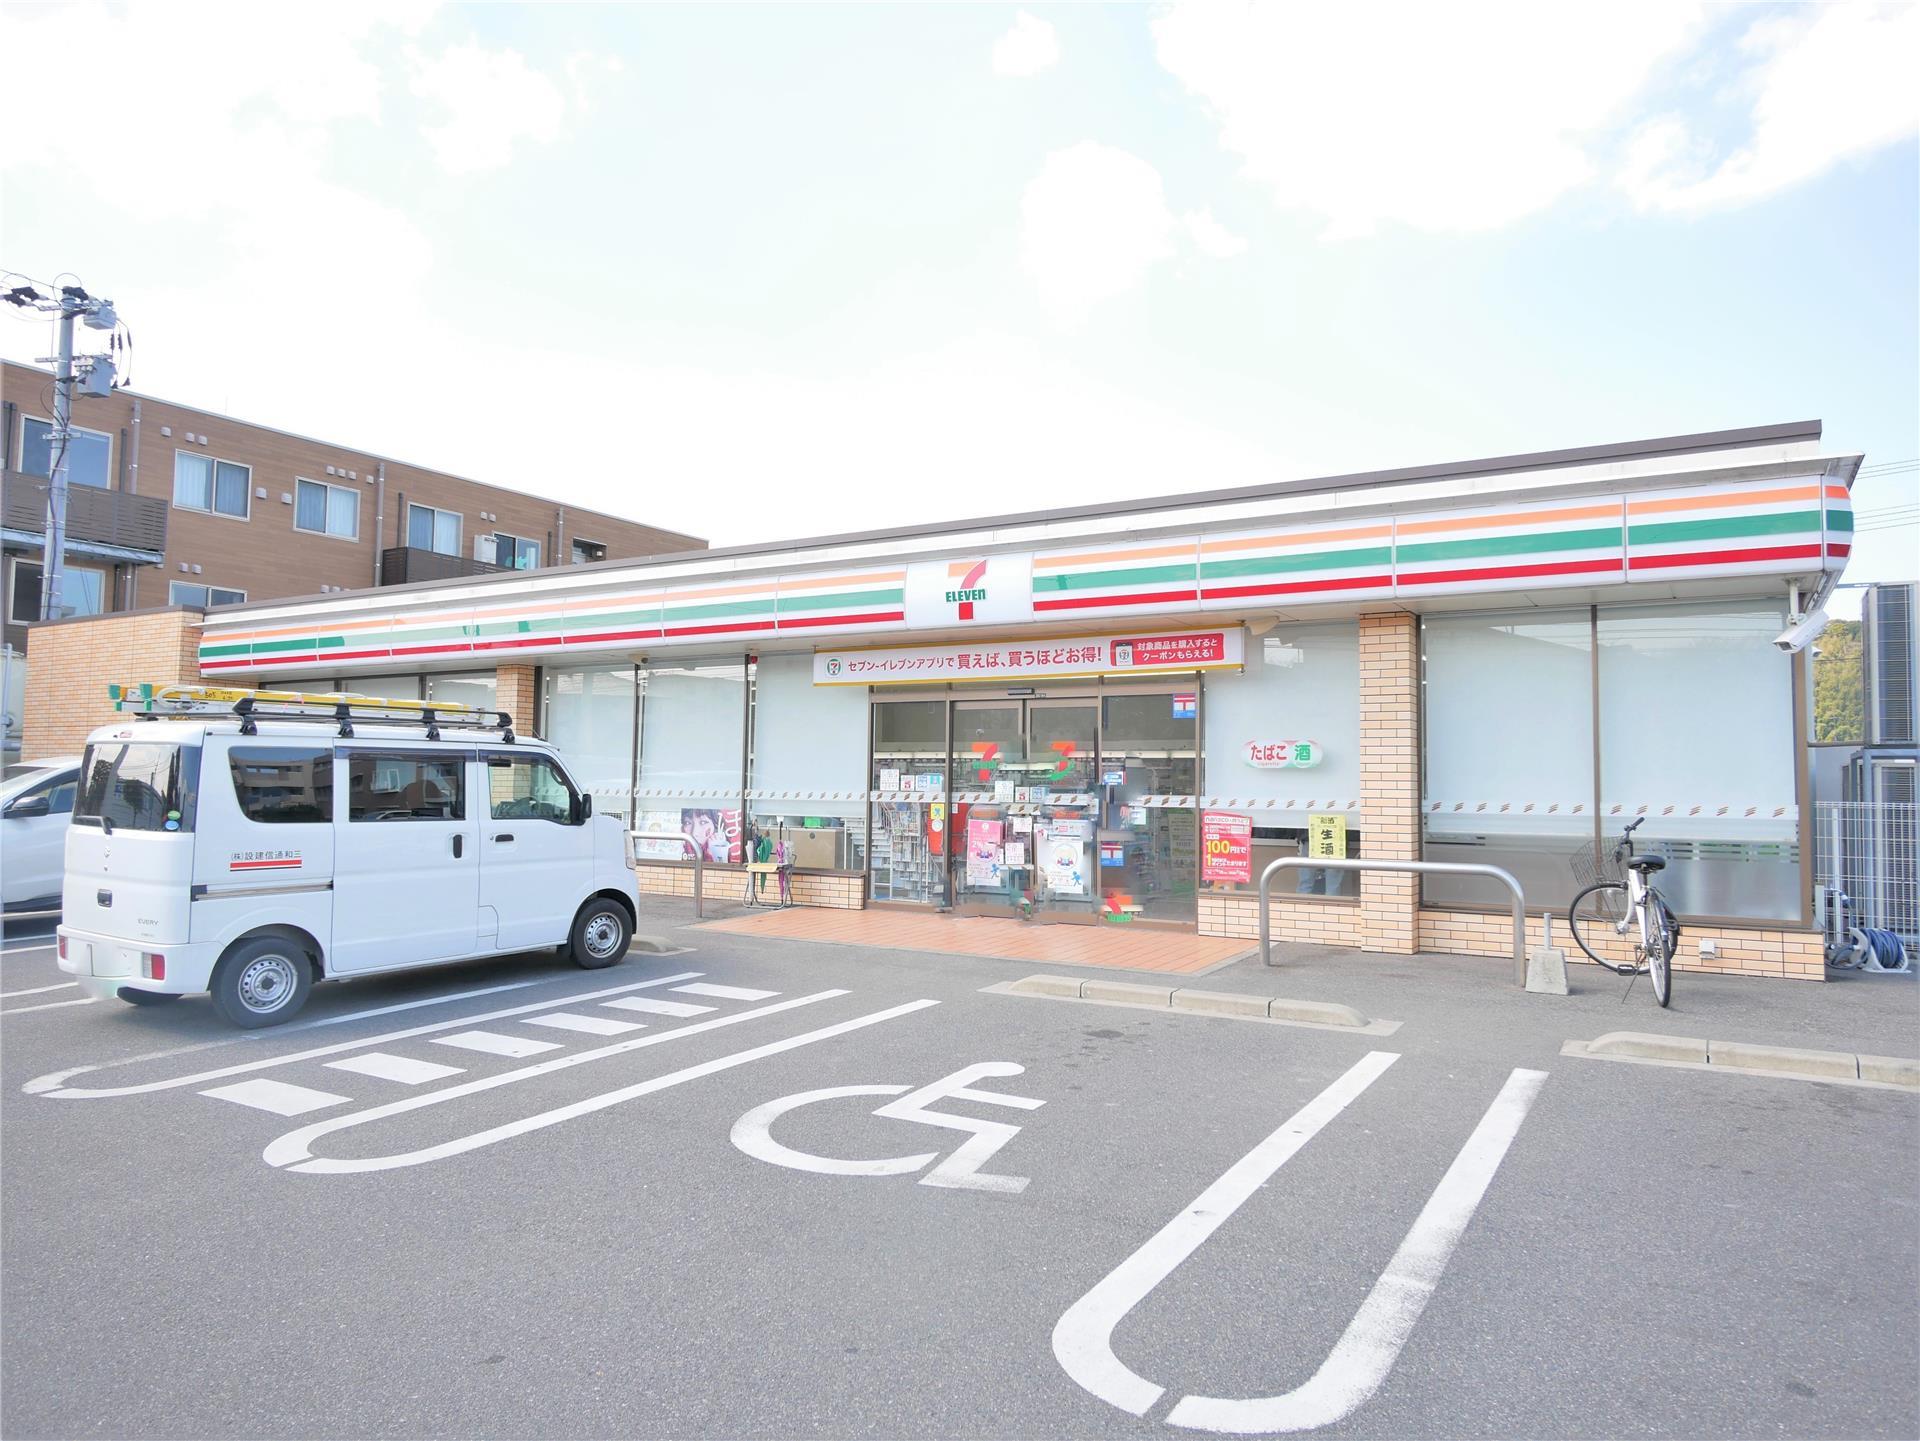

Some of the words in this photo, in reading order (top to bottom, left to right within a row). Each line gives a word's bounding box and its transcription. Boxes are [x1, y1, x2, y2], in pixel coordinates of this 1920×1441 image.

[1136, 638, 1218, 651] 対象商品を購入すると
[1142, 649, 1214, 661] クーポンもらえる!
[1251, 744, 1287, 760] たばこ
[1295, 744, 1311, 761] 酒
[1320, 829, 1334, 855] 生酒
